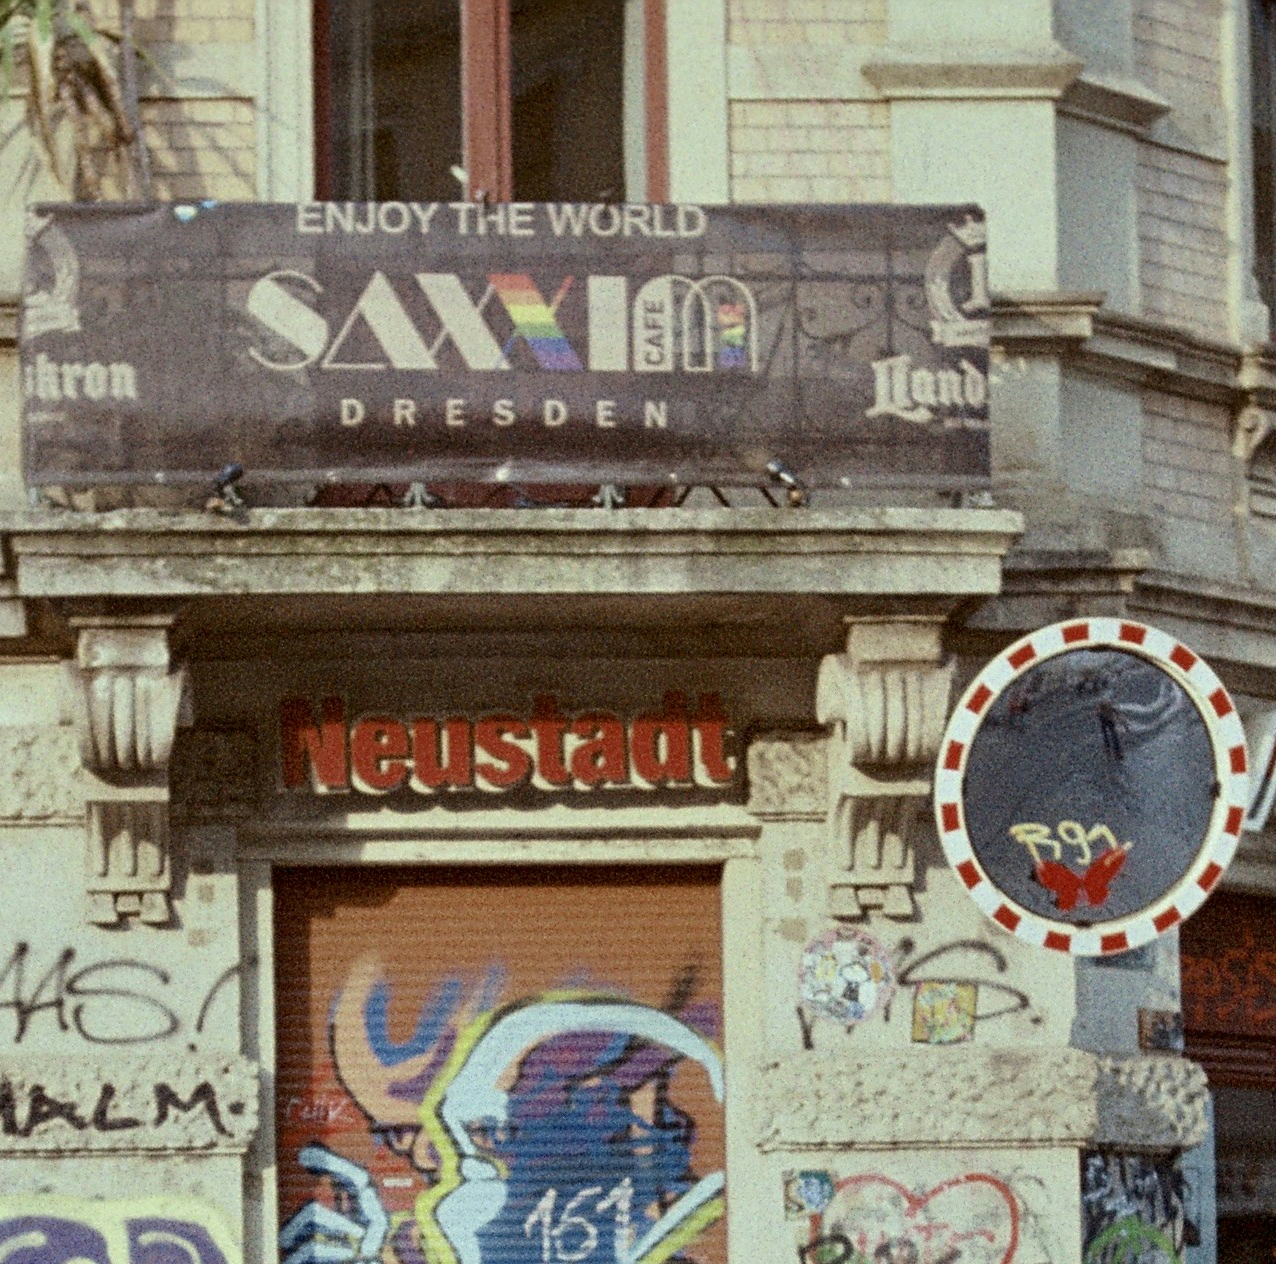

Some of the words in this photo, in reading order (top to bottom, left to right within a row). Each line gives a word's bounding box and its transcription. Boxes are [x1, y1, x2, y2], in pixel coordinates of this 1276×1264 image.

[296, 203, 431, 236] ENJOY
[450, 203, 534, 237] THE
[548, 203, 708, 239] WORLD
[643, 297, 666, 366] CAFE
[340, 399, 668, 429] DRESDEN
[281, 693, 736, 793] Neustadt
